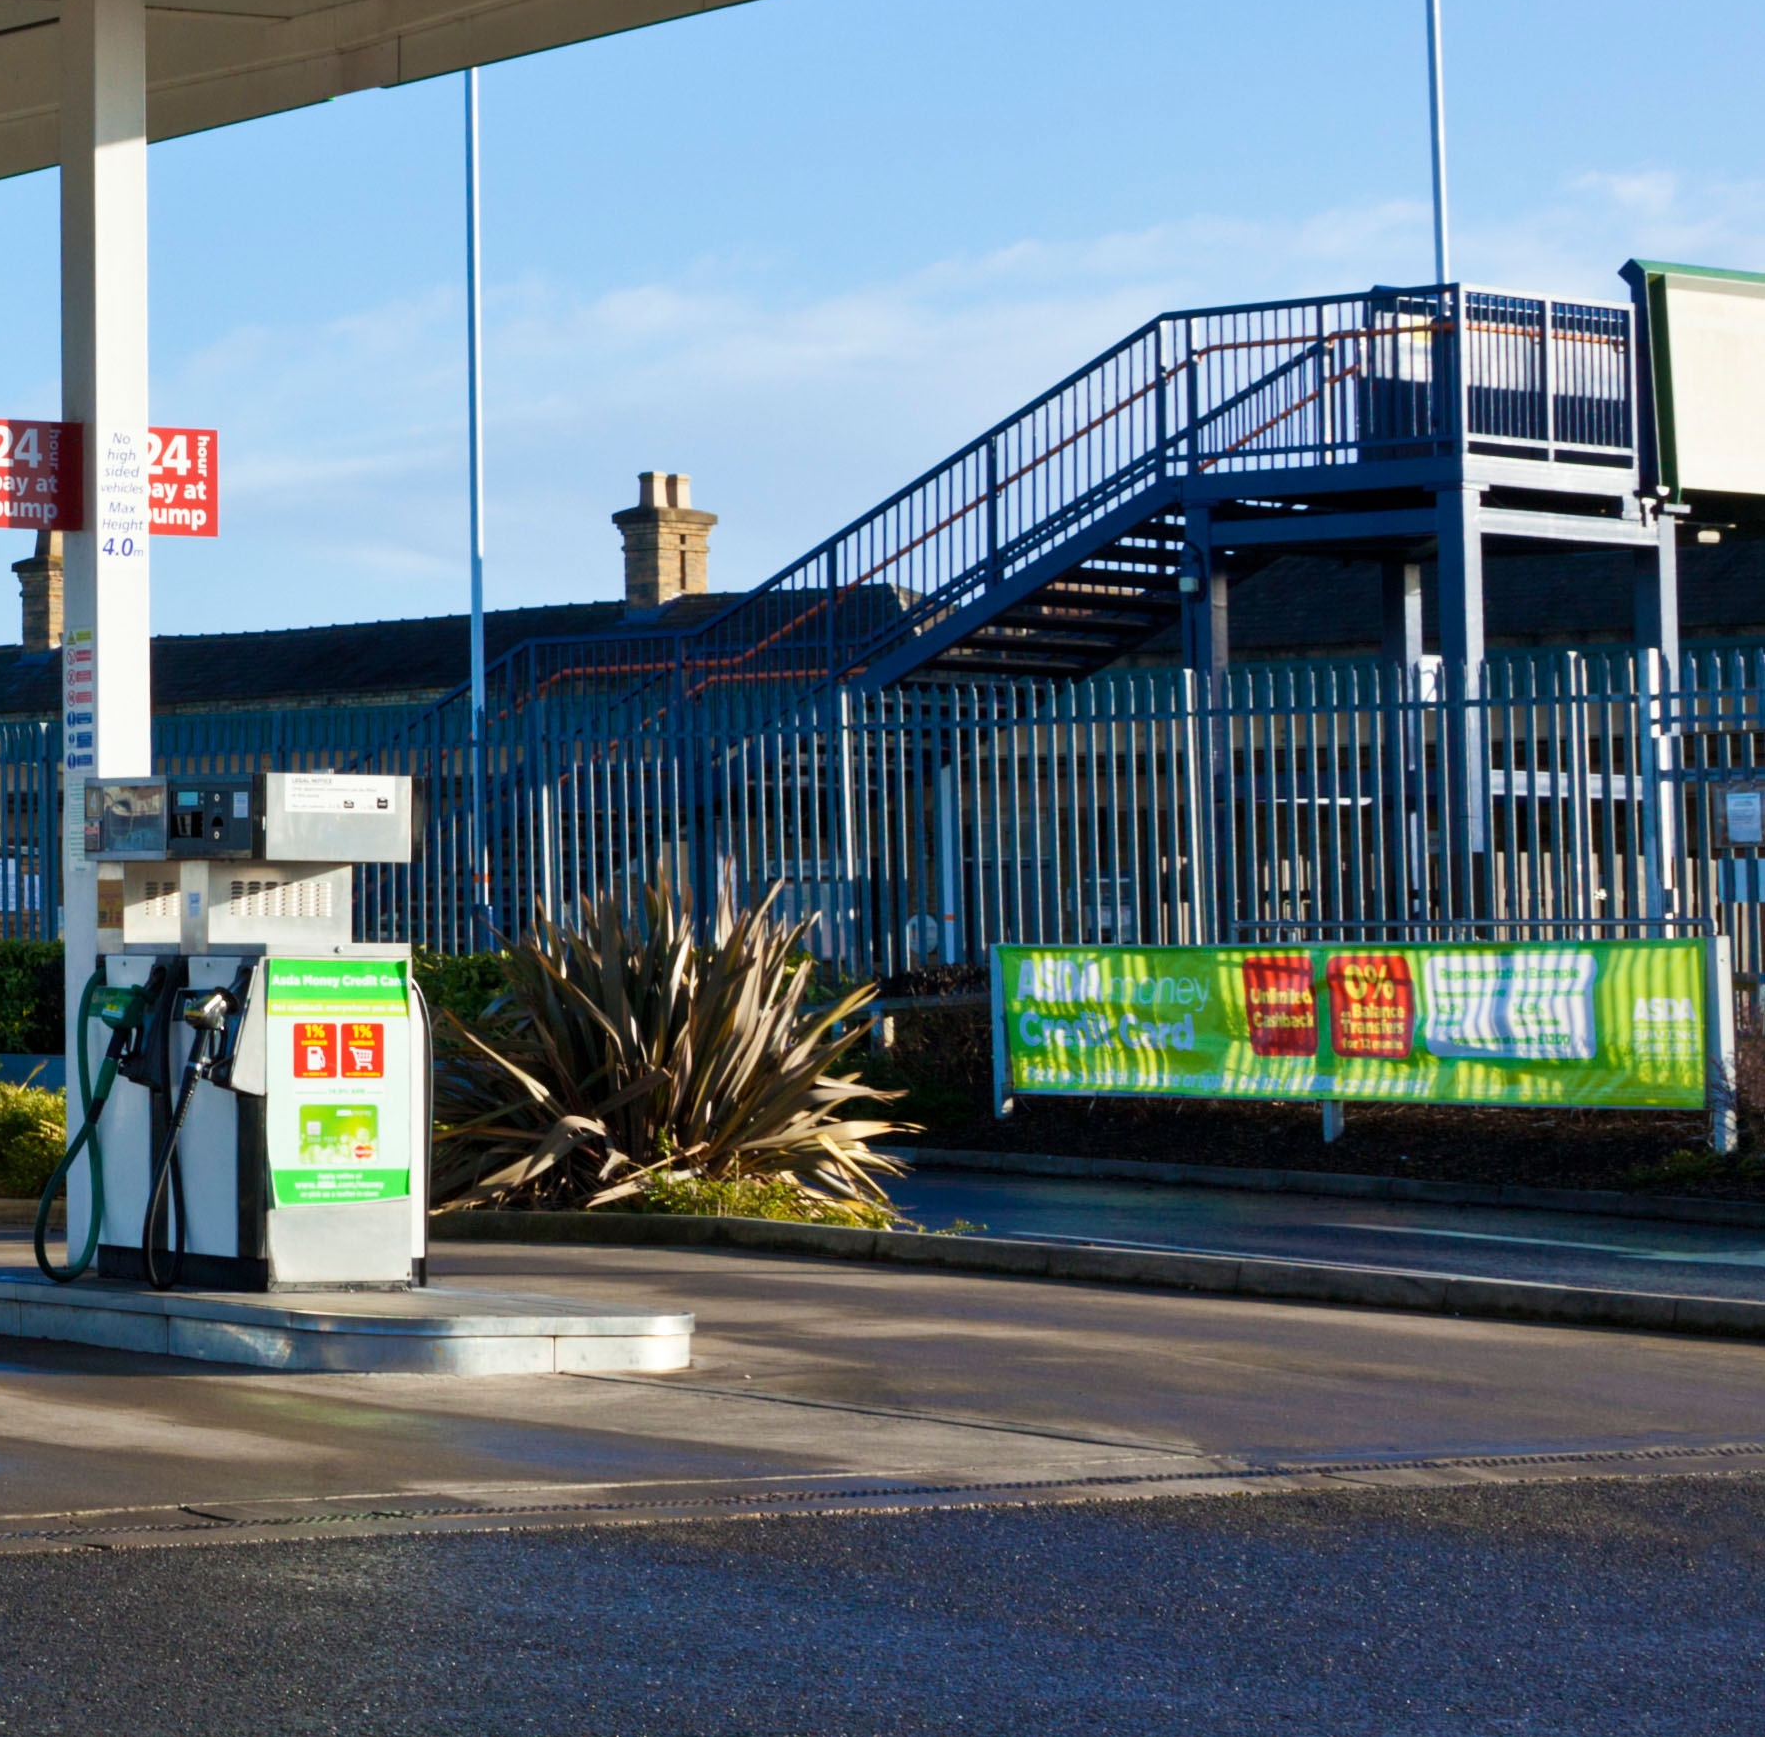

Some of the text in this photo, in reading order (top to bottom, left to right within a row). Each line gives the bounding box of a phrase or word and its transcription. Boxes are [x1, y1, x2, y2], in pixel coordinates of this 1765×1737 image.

[112, 432, 131, 445] No
[49, 429, 61, 470] hour
[107, 449, 136, 466] high
[197, 436, 210, 477] hour
[104, 466, 140, 478] sided
[36, 475, 58, 493] at
[101, 482, 144, 494] vehicles
[149, 481, 207, 504] ay at
[109, 502, 135, 514] Max
[102, 518, 143, 534] Height
[149, 507, 207, 531] ump
[272, 975, 300, 986] Asda
[303, 975, 340, 988] Money
[342, 975, 377, 986] Credit
[1344, 964, 1395, 1000] 0%
[1529, 967, 1580, 982] Example
[1017, 958, 1210, 1012] ASDA money
[1250, 987, 1313, 1004] Unlimited
[1352, 1003, 1405, 1019] Balance
[1632, 997, 1696, 1022] ASDA
[1253, 1011, 1314, 1028] Cashback
[1340, 1018, 1405, 1034] Transfers
[304, 1024, 325, 1038] 1%
[352, 1024, 373, 1038] 1%
[1020, 1010, 1195, 1051] Credit Card
[1343, 1038, 1357, 1049] for
